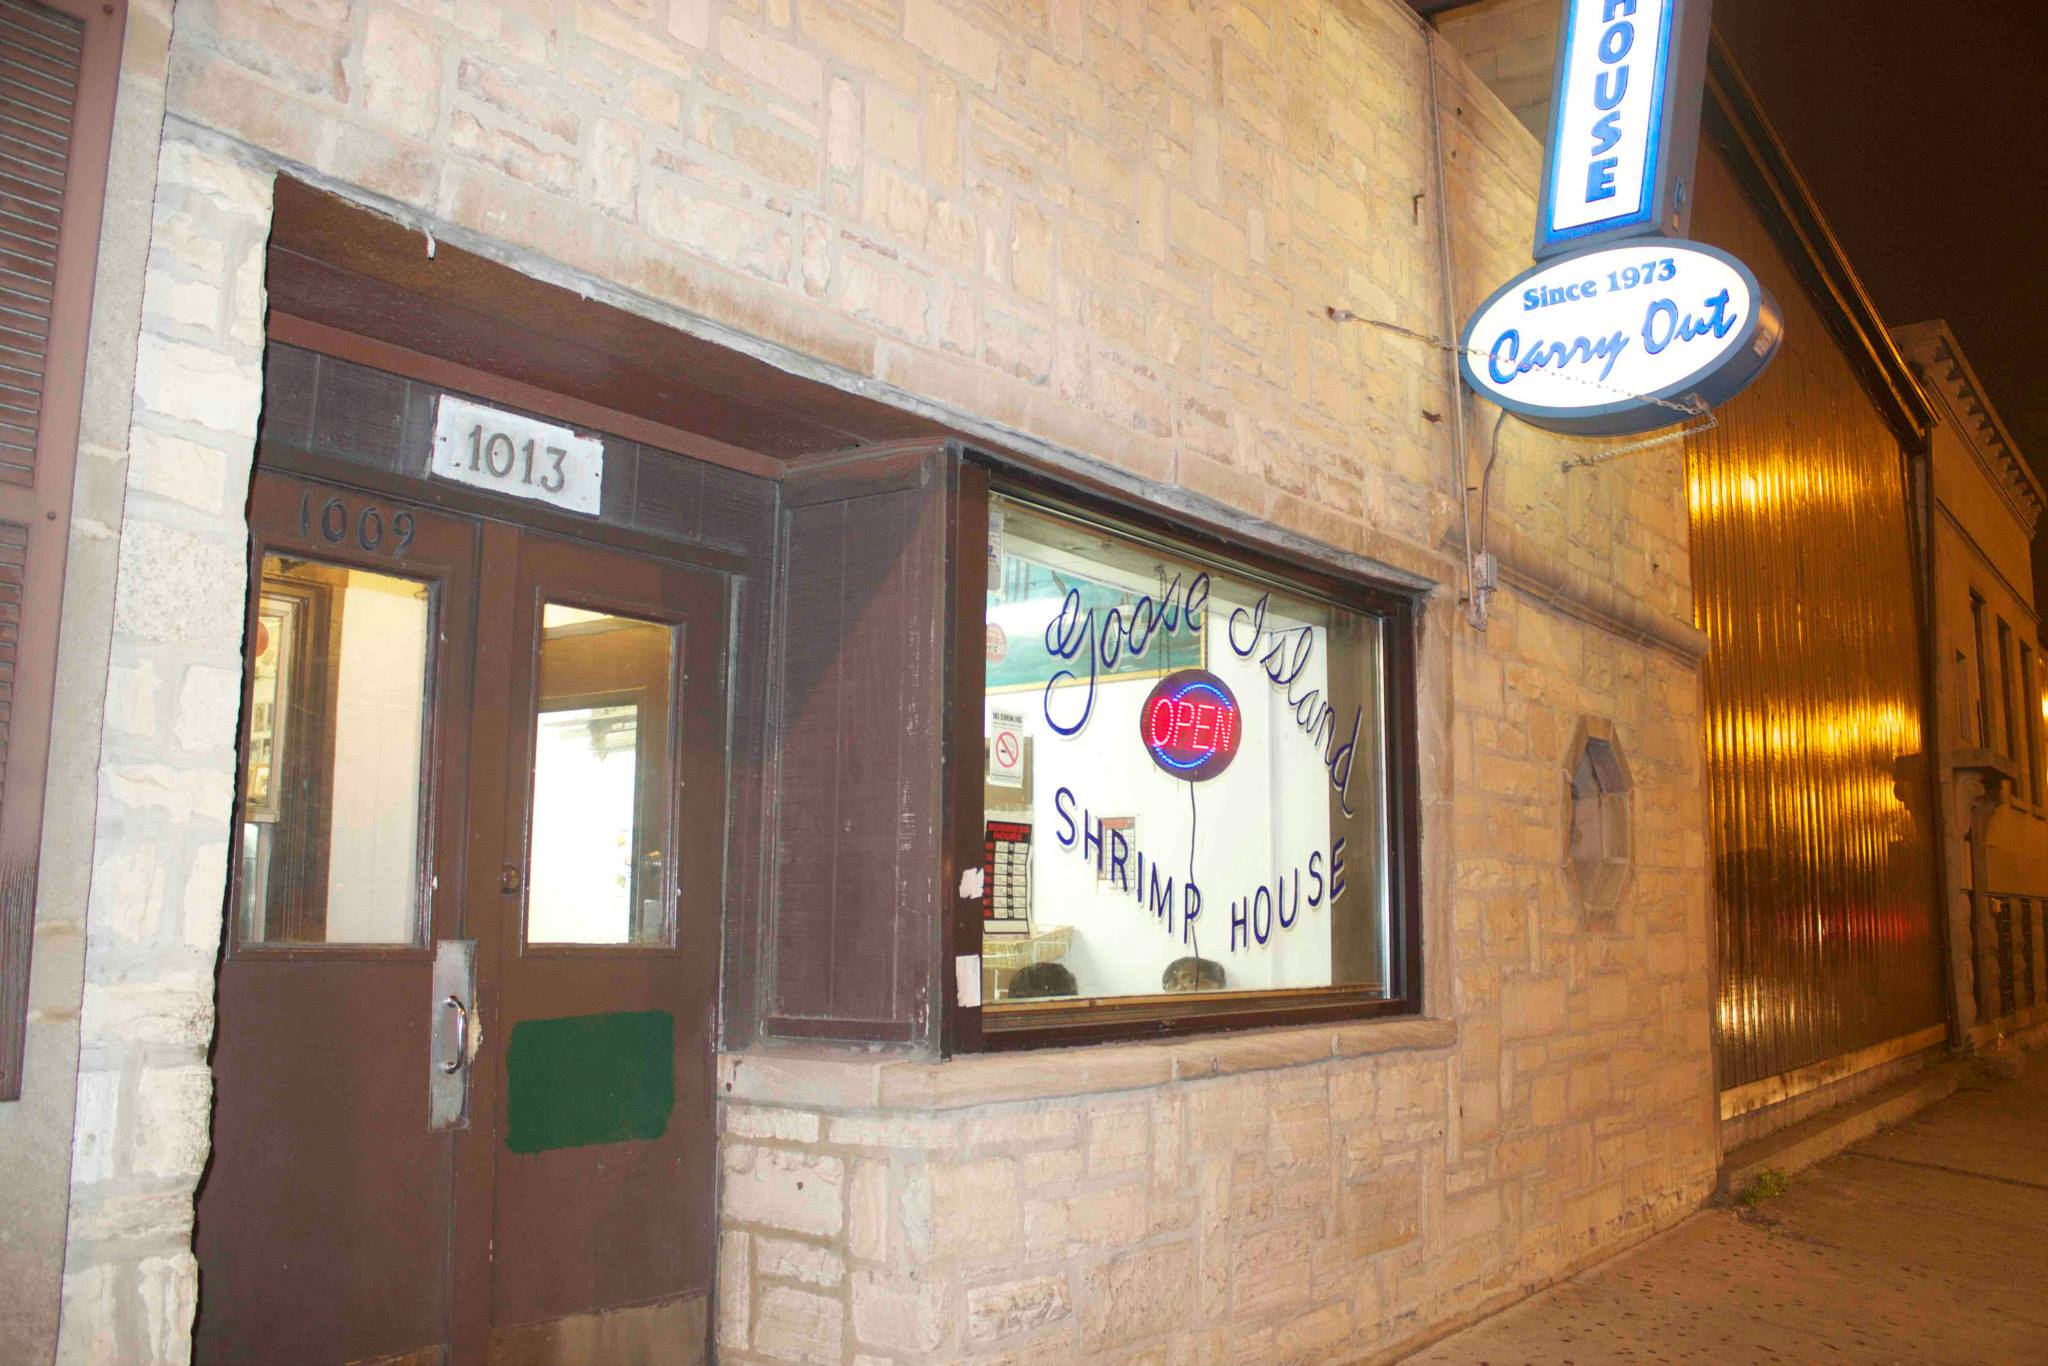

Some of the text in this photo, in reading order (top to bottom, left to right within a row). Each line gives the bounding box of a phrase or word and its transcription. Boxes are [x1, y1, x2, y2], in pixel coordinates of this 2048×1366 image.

[1523, 258, 1676, 311] Since 1973
[1488, 288, 1738, 384] Carry Out
[468, 424, 567, 493] 1013
[301, 491, 415, 556] 1009
[1044, 571, 1362, 817] Goose Island
[1151, 697, 1234, 751] OPEN
[1054, 786, 1201, 944] SHRIMP
[1231, 837, 1345, 951] HOUSE
